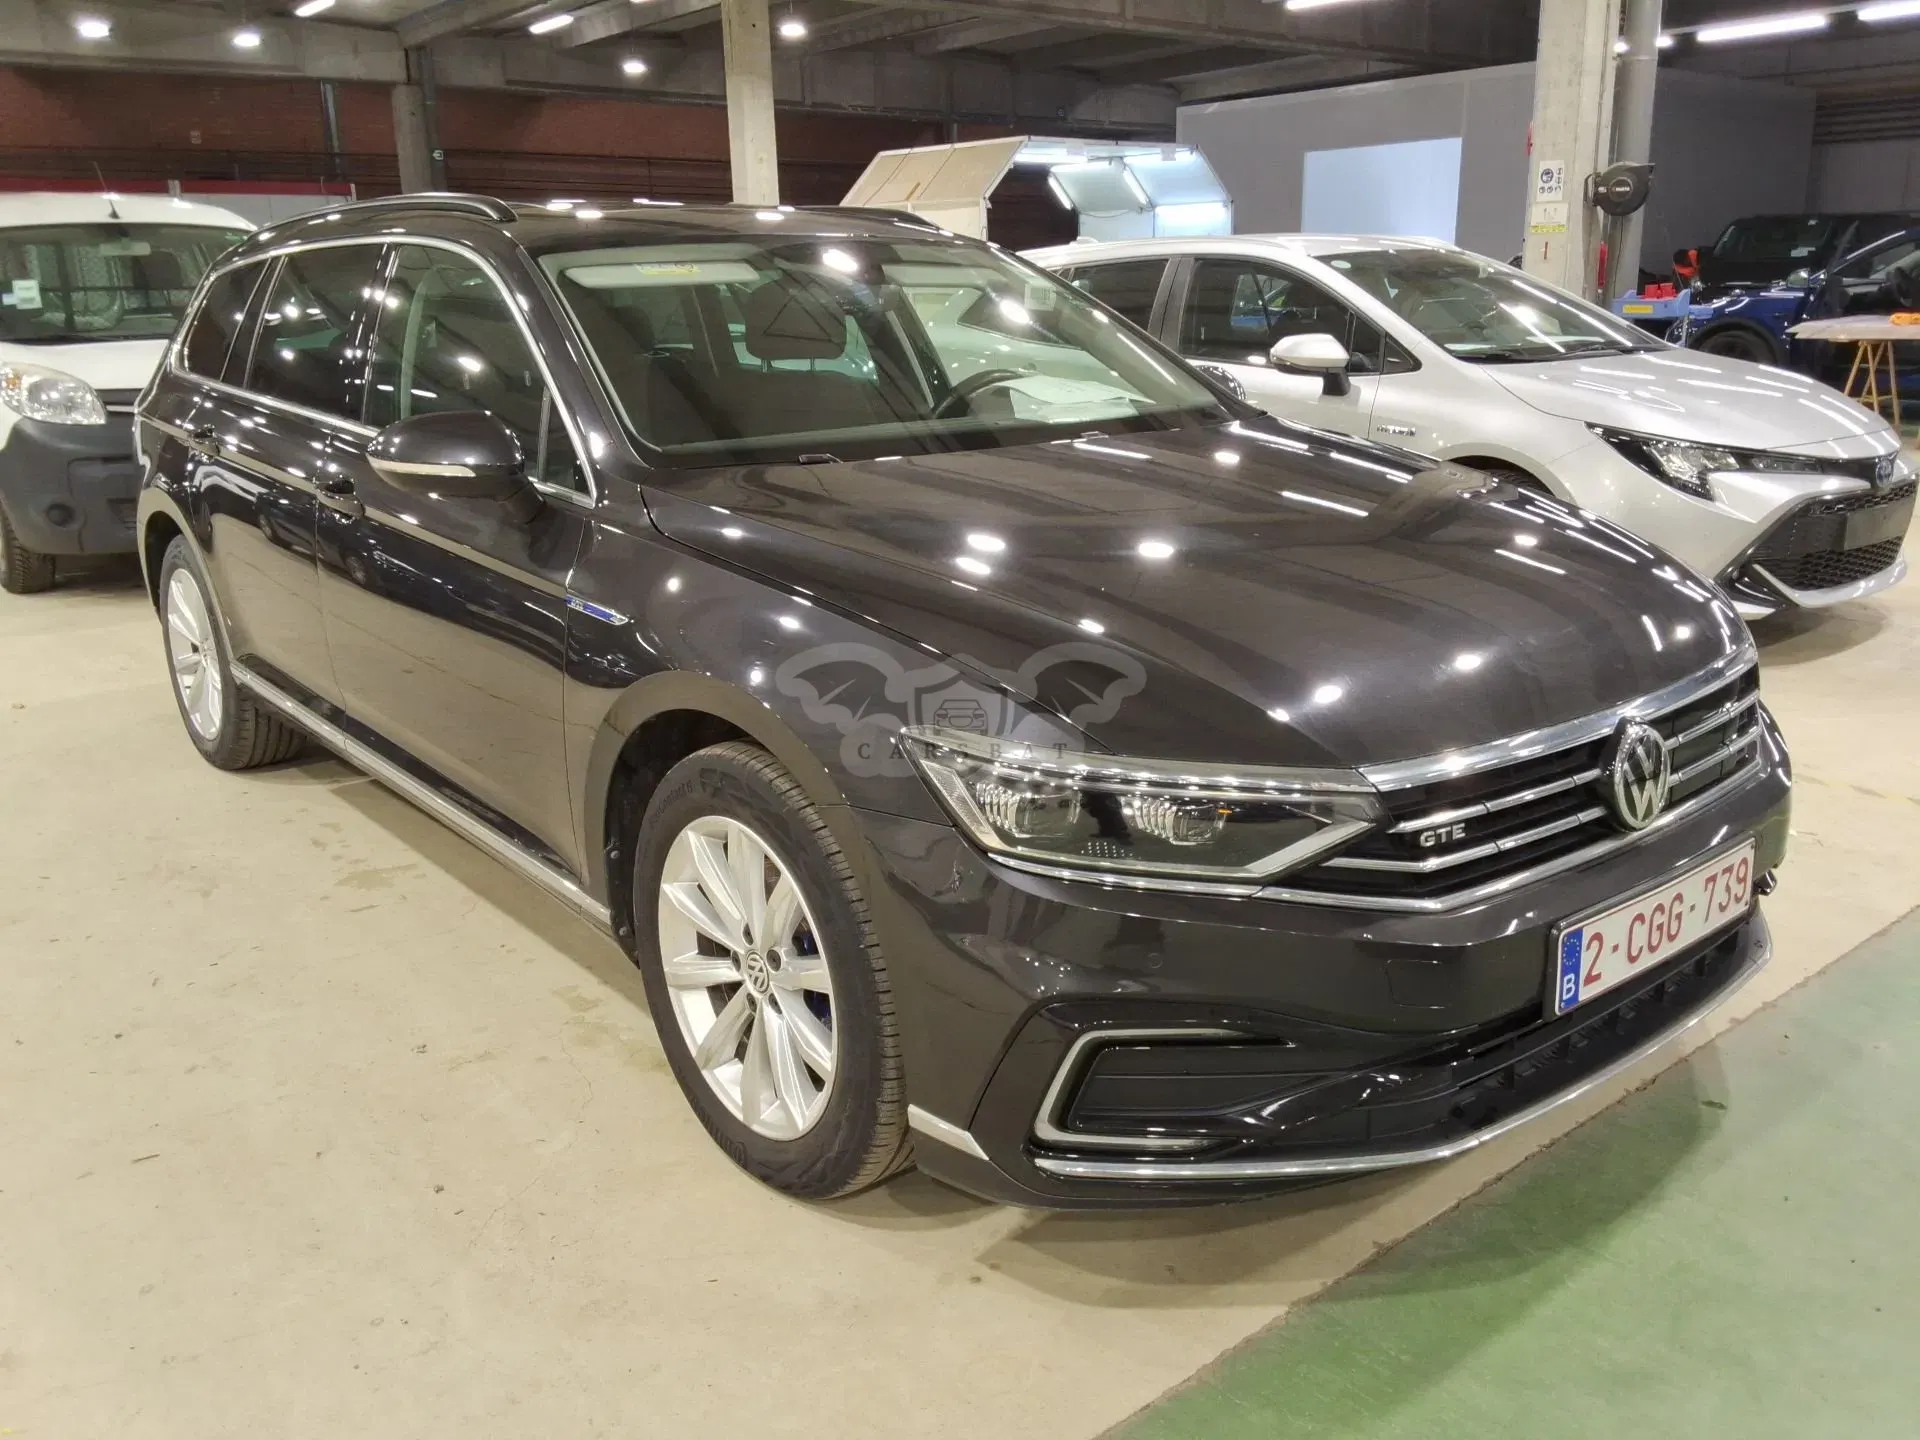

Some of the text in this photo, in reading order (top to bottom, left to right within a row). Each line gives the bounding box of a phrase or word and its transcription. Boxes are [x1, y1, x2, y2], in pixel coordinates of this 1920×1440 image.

[1420, 822, 1466, 847] GTE
[1583, 857, 1749, 988] 2-CGG-739
[1562, 973, 1576, 1001] B
